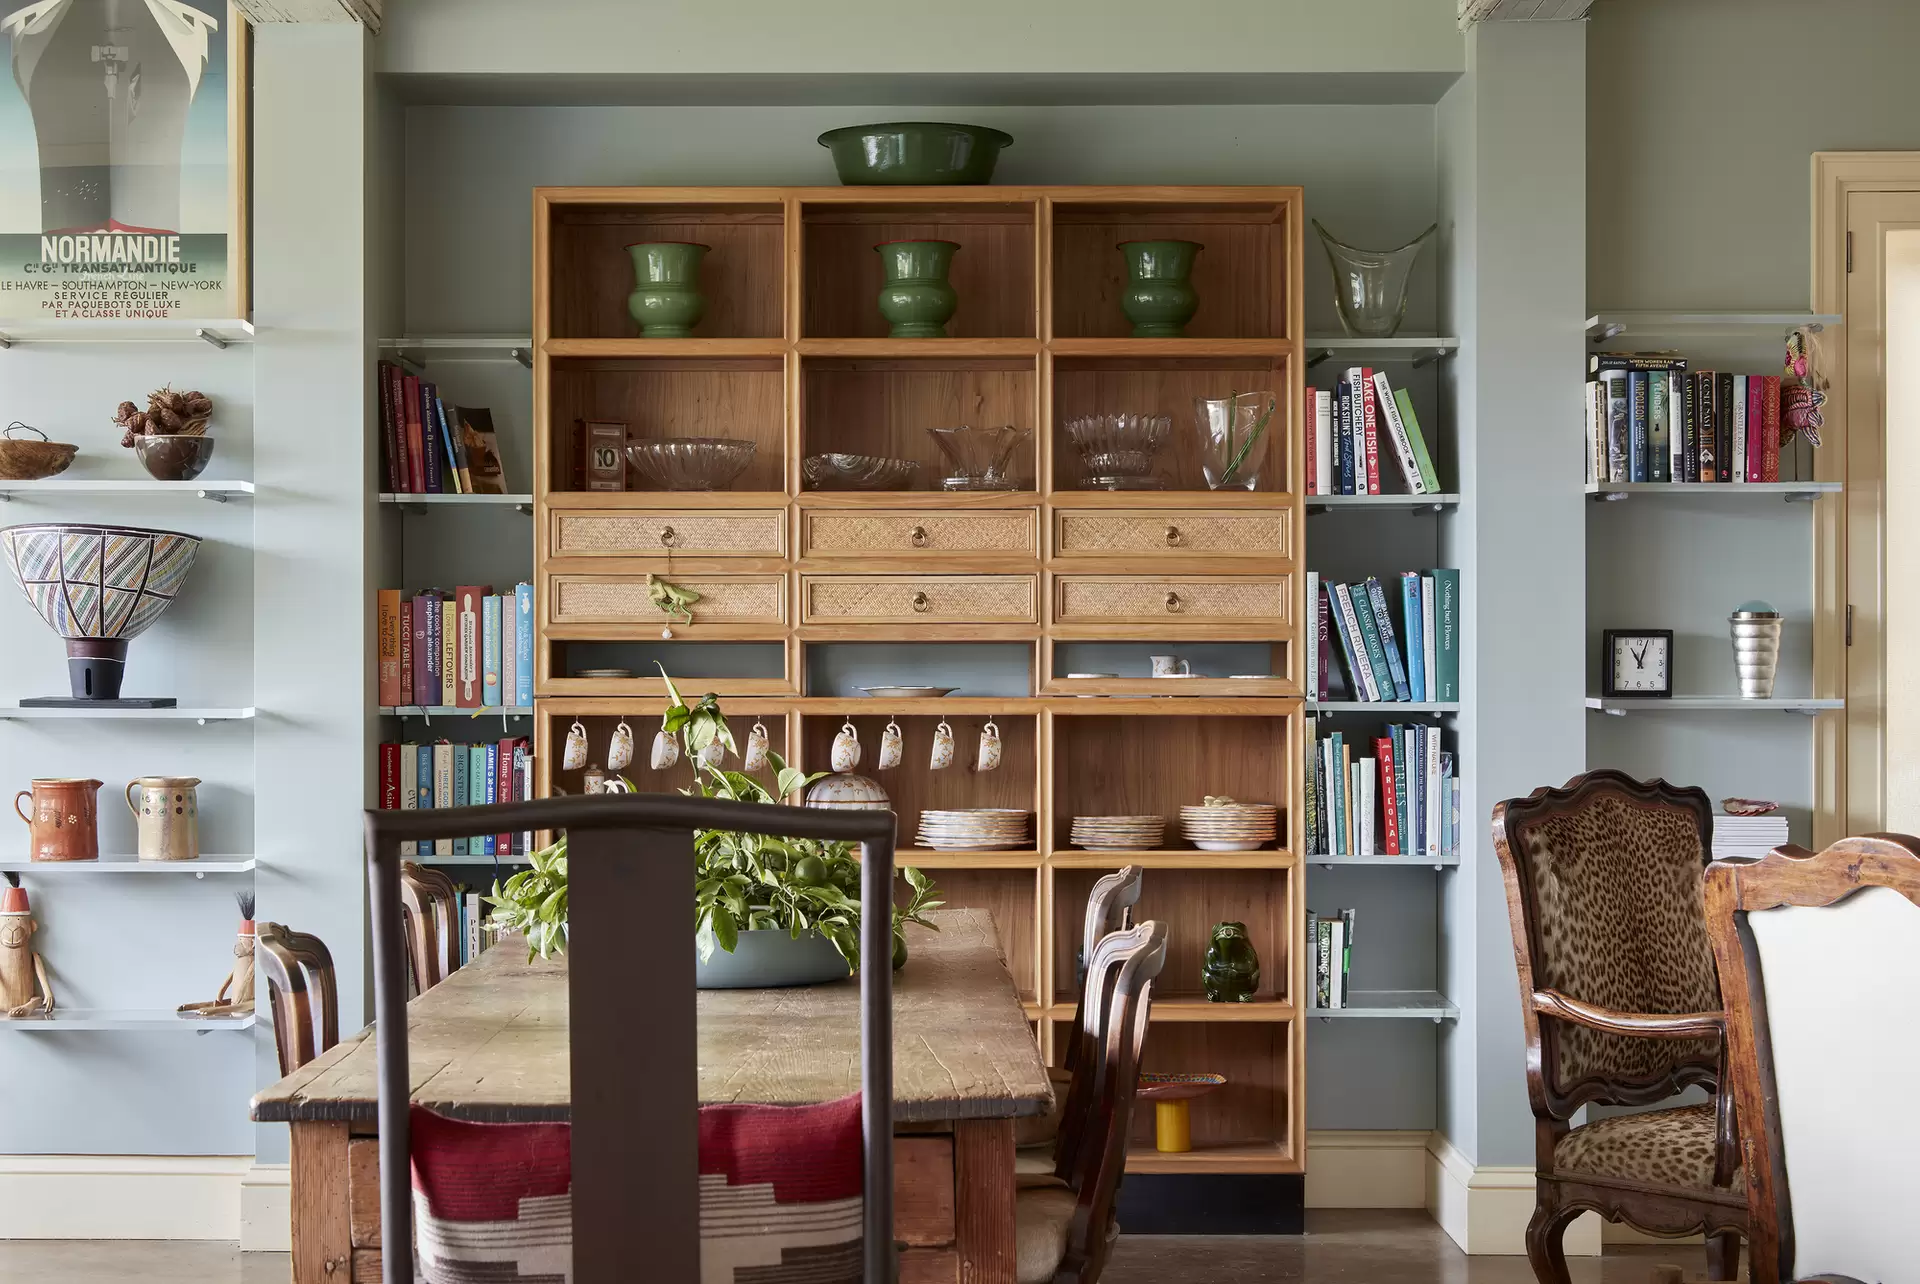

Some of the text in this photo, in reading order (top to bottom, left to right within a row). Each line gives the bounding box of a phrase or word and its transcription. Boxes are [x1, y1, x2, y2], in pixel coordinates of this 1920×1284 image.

[41, 235, 180, 263] NORMANDIE
[61, 263, 197, 274] TRANSATLANTIQUE
[1, 281, 222, 290] LE HAVRE SOUTHAMPTON NEW-YORK
[54, 290, 168, 300] SERVICE RÉGULIER
[42, 300, 180, 310] PAR PAQUEBOTS DE LUXE
[56, 310, 68, 318] ET
[82, 310, 120, 318] CLASSE
[126, 310, 168, 318] UNIQUE
[1342, 396, 1350, 411] RICK
[1353, 374, 1363, 436] FISH BUTCHERY
[1635, 380, 1644, 420] NAPOLEON
[1704, 379, 1712, 405] CONDÉ
[1342, 412, 1350, 436] STEIN'S
[1363, 376, 1376, 454] TAKE ONE FISH
[1384, 391, 1394, 410] WHOLE
[1395, 423, 1409, 454] COOKBOOK
[597, 449, 616, 467] 10
[1443, 580, 1452, 609] (Nothing
[1319, 598, 1327, 641] LILACS
[1358, 599, 1374, 630] CLASSIC
[1368, 633, 1381, 659] ROSES
[1380, 619, 1390, 644] PLANTS
[1338, 588, 1356, 632] FRENCH
[1353, 636, 1371, 680] RIVIERA
[381, 662, 389, 683] Perry
[502, 752, 510, 778] Home
[386, 784, 395, 809] Asian
[1394, 762, 1406, 806] TREES
[1320, 937, 1328, 973] WILDING
